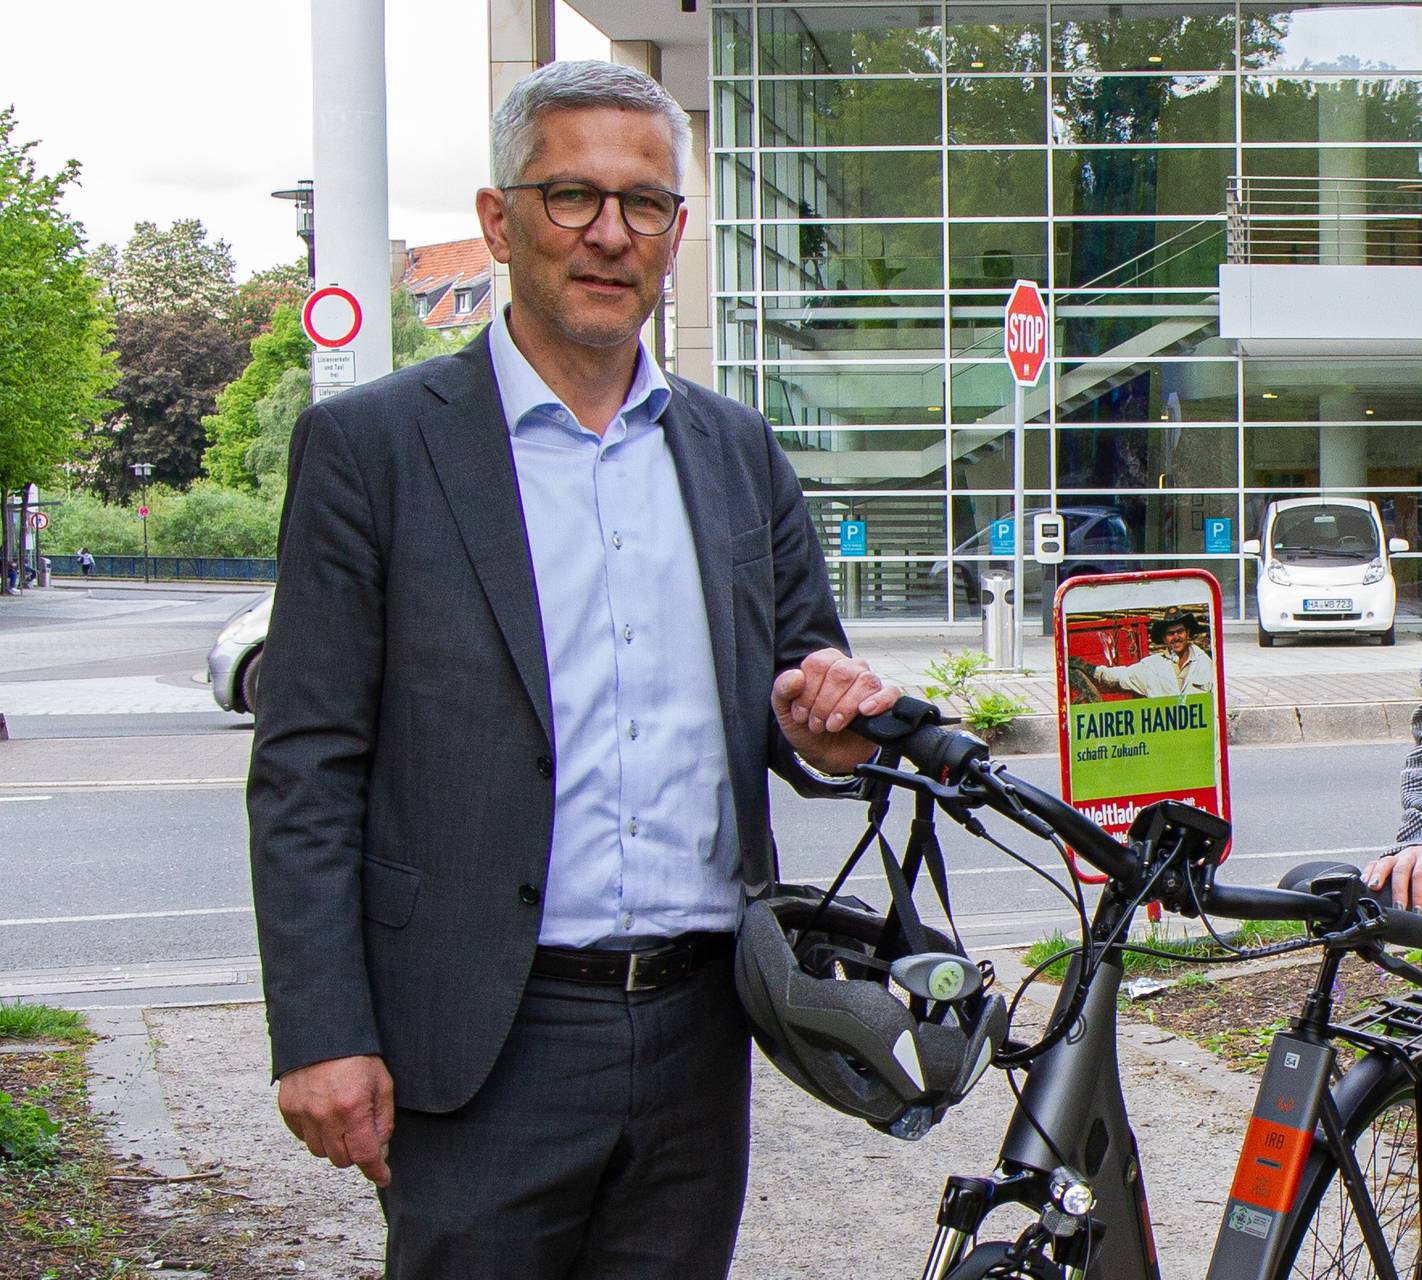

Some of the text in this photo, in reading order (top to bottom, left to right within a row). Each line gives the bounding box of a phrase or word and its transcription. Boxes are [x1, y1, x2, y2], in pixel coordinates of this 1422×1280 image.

[1009, 312, 1044, 354] STOP
[847, 525, 858, 540] P
[998, 524, 1009, 539] P
[1213, 522, 1224, 538] P
[1076, 703, 1208, 740] FAIRER HANDEL
[1077, 741, 1150, 762] schafft Zukunft.
[1079, 801, 1146, 826] Weltlade
[1286, 1057, 1297, 1067] 54
